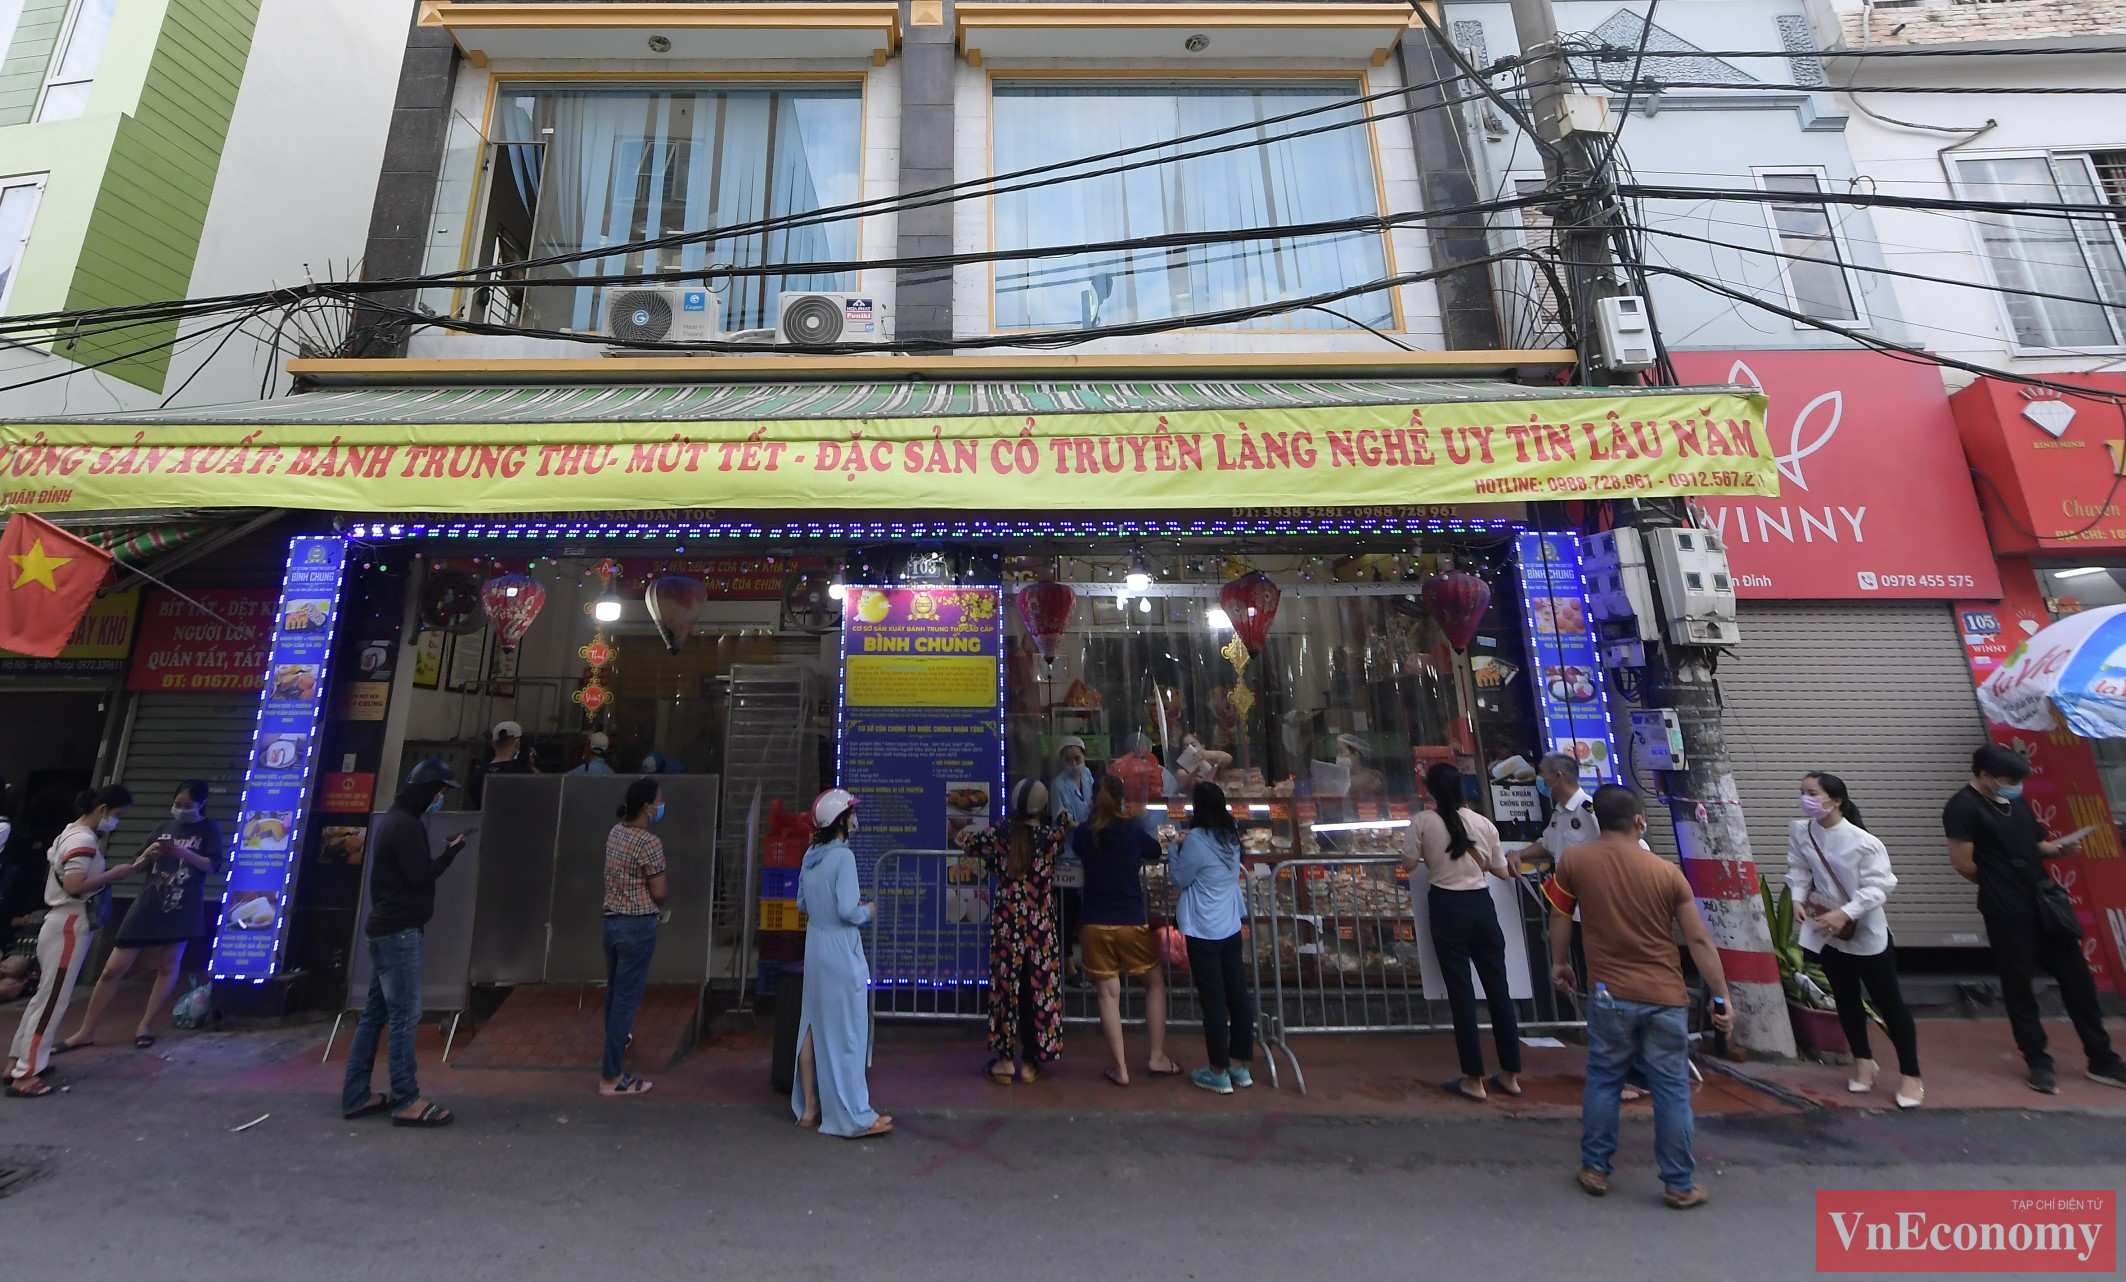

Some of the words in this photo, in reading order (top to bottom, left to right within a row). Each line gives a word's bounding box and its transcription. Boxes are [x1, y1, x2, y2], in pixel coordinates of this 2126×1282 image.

[89, 431, 174, 475] SẢN
[166, 430, 284, 475] XUẤT:
[285, 435, 398, 478] BÁNH
[400, 444, 527, 478] TRUNG
[624, 433, 708, 473] MỨT
[718, 427, 787, 471] TẾT
[814, 430, 893, 482] ĐẶC
[904, 425, 979, 474] SẢN
[990, 416, 1039, 475] CỔ
[1050, 415, 1202, 474] TRUYỀN
[1213, 422, 1318, 471] LÀNG
[1325, 409, 1436, 467] NGHỀ
[1441, 426, 1495, 464] UY
[1506, 414, 1577, 463] TÍN
[1582, 410, 1663, 460] LÂU
[1668, 407, 1760, 459] NĂM
[1474, 478, 1543, 494] HOTLINE:
[1548, 473, 1652, 492] 0988.728.961
[38, 486, 73, 503] ĐỈNH
[1306, 507, 1343, 518] 5281
[1354, 507, 1393, 518] 0988
[1398, 507, 1427, 517] 728
[1430, 506, 1458, 517] 961
[911, 559, 937, 575] 103
[1527, 568, 1547, 579] BÌNH
[1548, 569, 1575, 580] CHUNG
[291, 571, 308, 582] BÌNH
[309, 572, 335, 582] CHUNG
[1742, 573, 1772, 587] Đỉnh
[1881, 575, 1916, 588] 0978
[1919, 575, 1945, 588] 455
[1948, 575, 1974, 588] 575
[97, 608, 129, 646] KHÔ
[173, 621, 221, 641] NGƯỜI
[1966, 614, 1997, 631] 105
[864, 633, 910, 652] BÌNH
[914, 637, 981, 652] CHUNG
